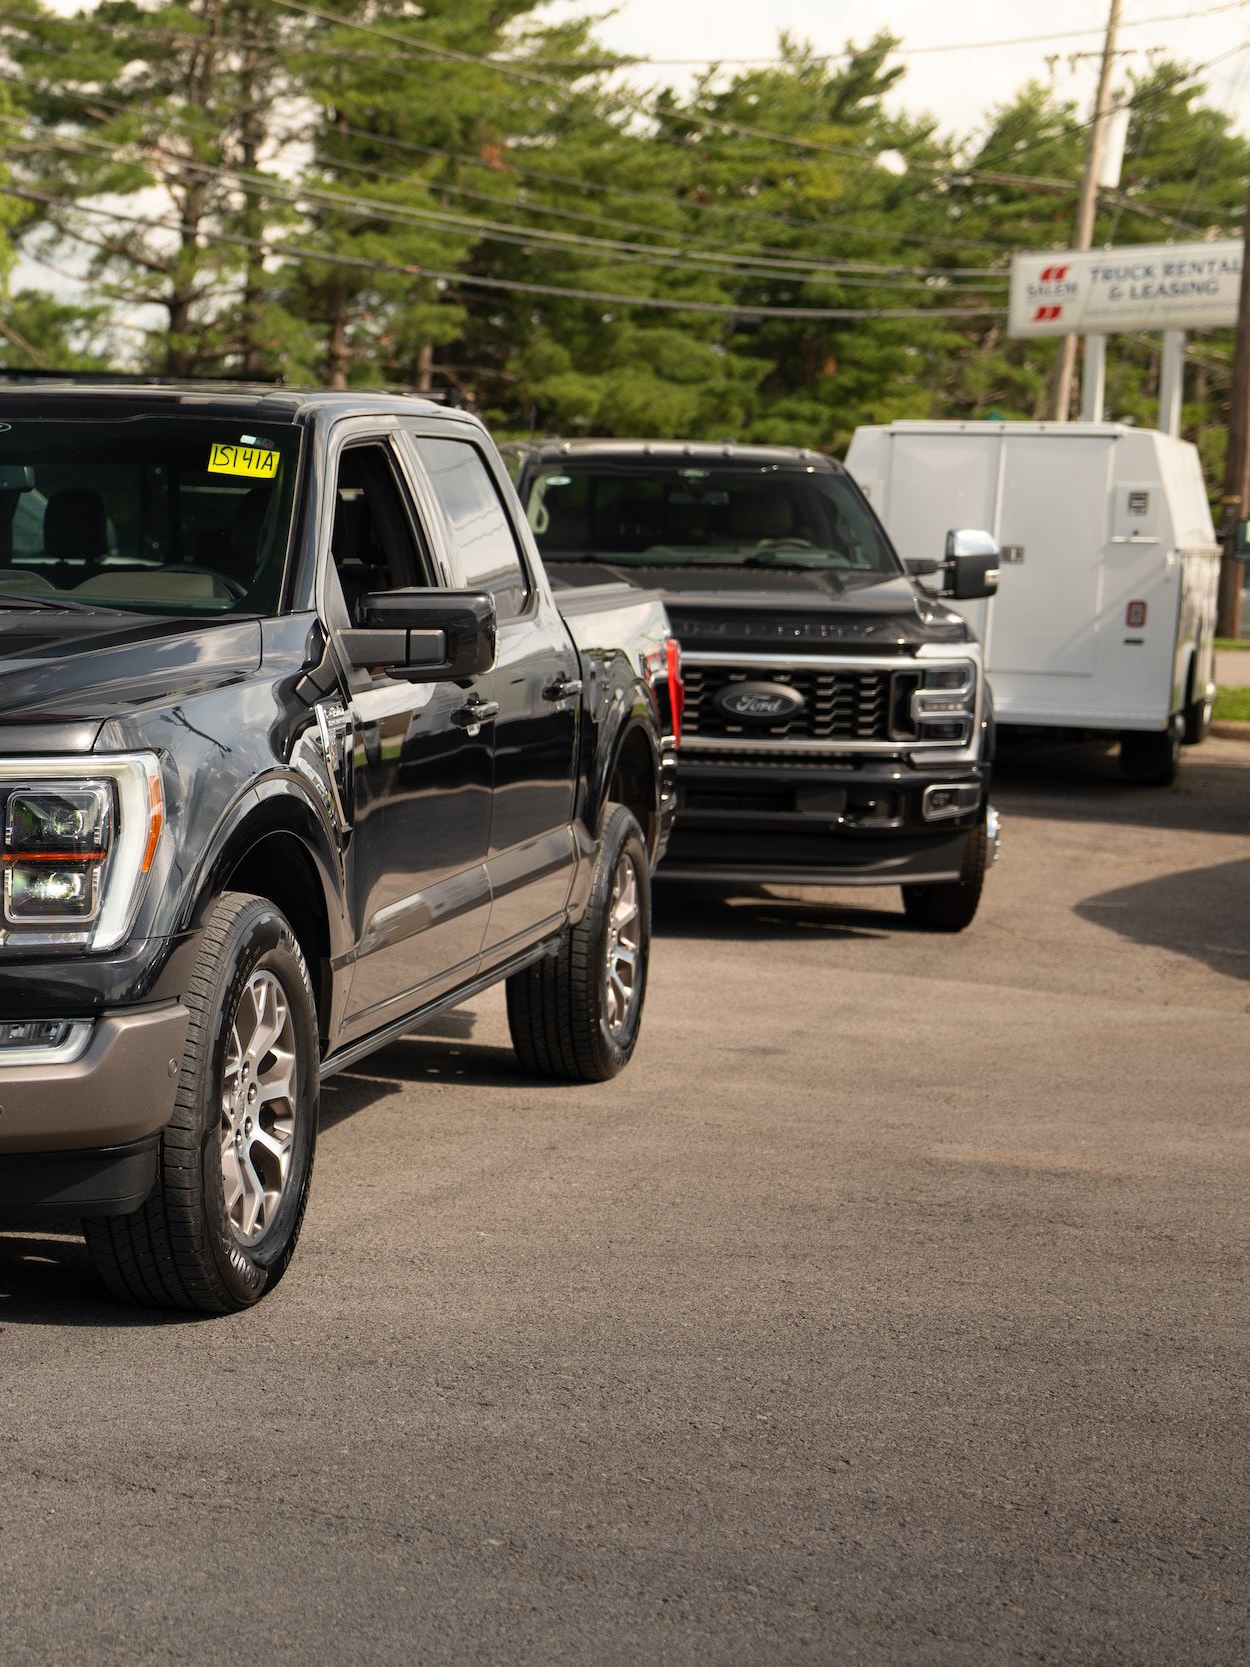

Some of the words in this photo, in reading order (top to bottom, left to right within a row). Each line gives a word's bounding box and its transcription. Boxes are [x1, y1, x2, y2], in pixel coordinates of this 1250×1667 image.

[1089, 262, 1154, 283] TRUCK
[1162, 257, 1241, 278] RENTAL
[1129, 278, 1220, 301] LEASING
[736, 694, 782, 711] Ford
